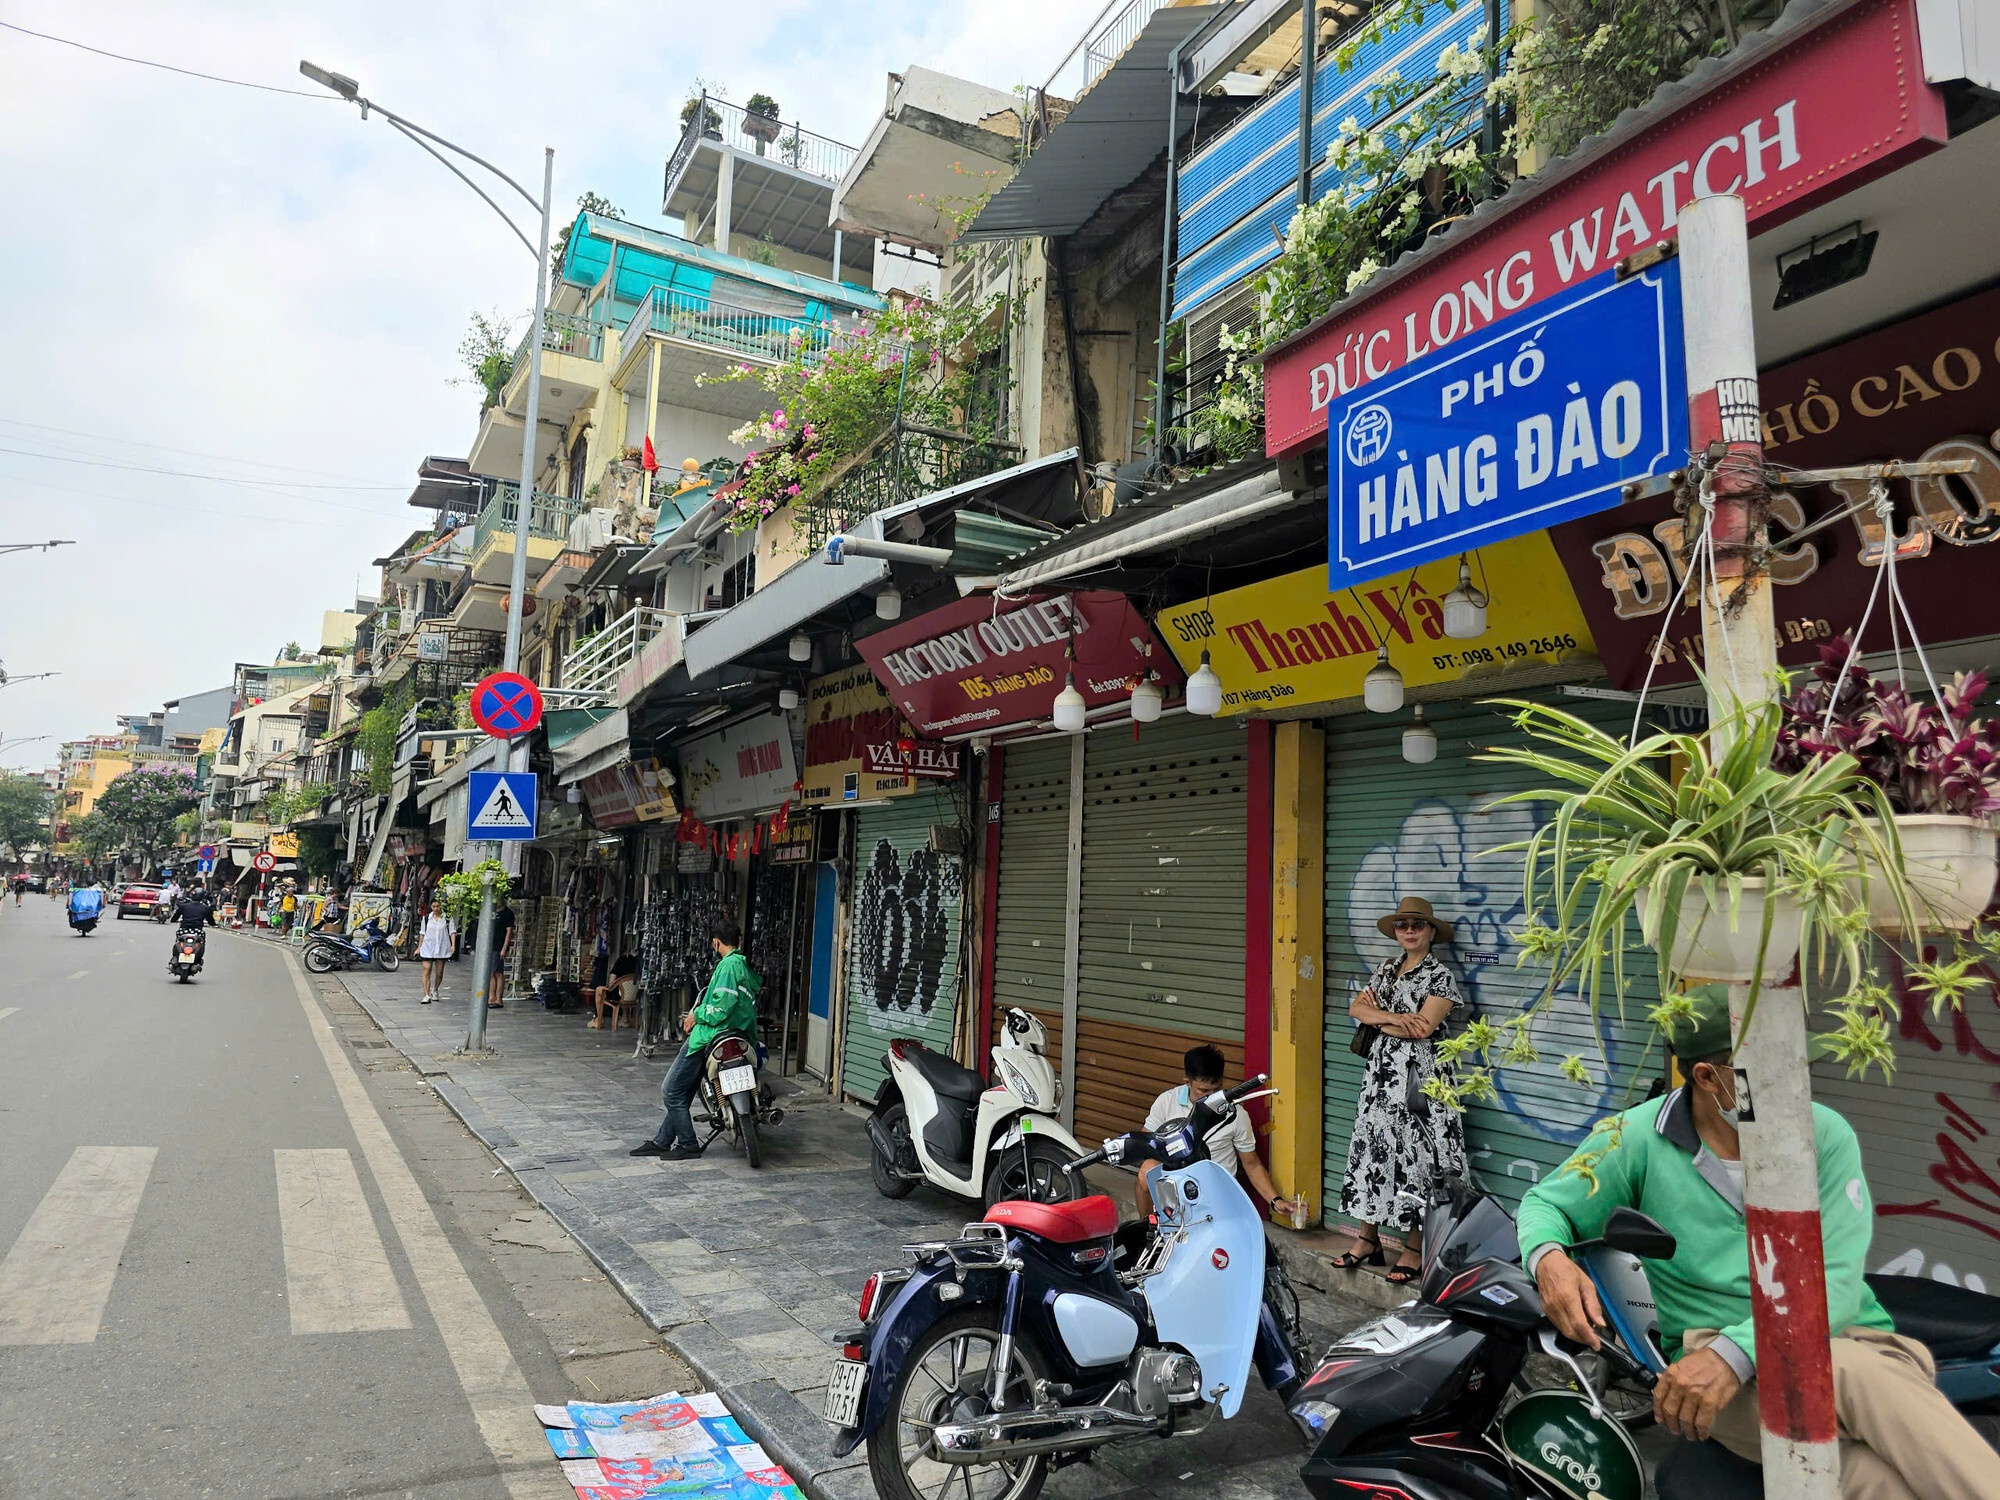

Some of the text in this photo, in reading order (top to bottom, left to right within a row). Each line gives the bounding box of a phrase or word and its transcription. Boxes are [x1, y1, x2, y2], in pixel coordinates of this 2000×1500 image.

[1309, 99, 1802, 412] ĐỨC LONG WATCH
[1440, 326, 1548, 419] PHỐ
[1761, 347, 1982, 450] HỒ CAO
[1357, 380, 1643, 545] HÀNG ĐÀO
[882, 594, 1082, 687] FACTORY OUTLET
[1172, 610, 1216, 642] SHOP
[1226, 600, 1379, 673] Thanh
[1785, 616, 1832, 643] Đào
[1433, 633, 1577, 670] ĐT: 098 149 2646
[958, 675, 992, 701] 105
[1024, 663, 1055, 687] ĐÀO
[1221, 684, 1295, 706] 107 Hàng Đào
[867, 741, 912, 765] VÂN
[728, 1079, 751, 1092] 1172
[832, 1363, 860, 1392] 29-C1
[1541, 1442, 1601, 1490] Grab
